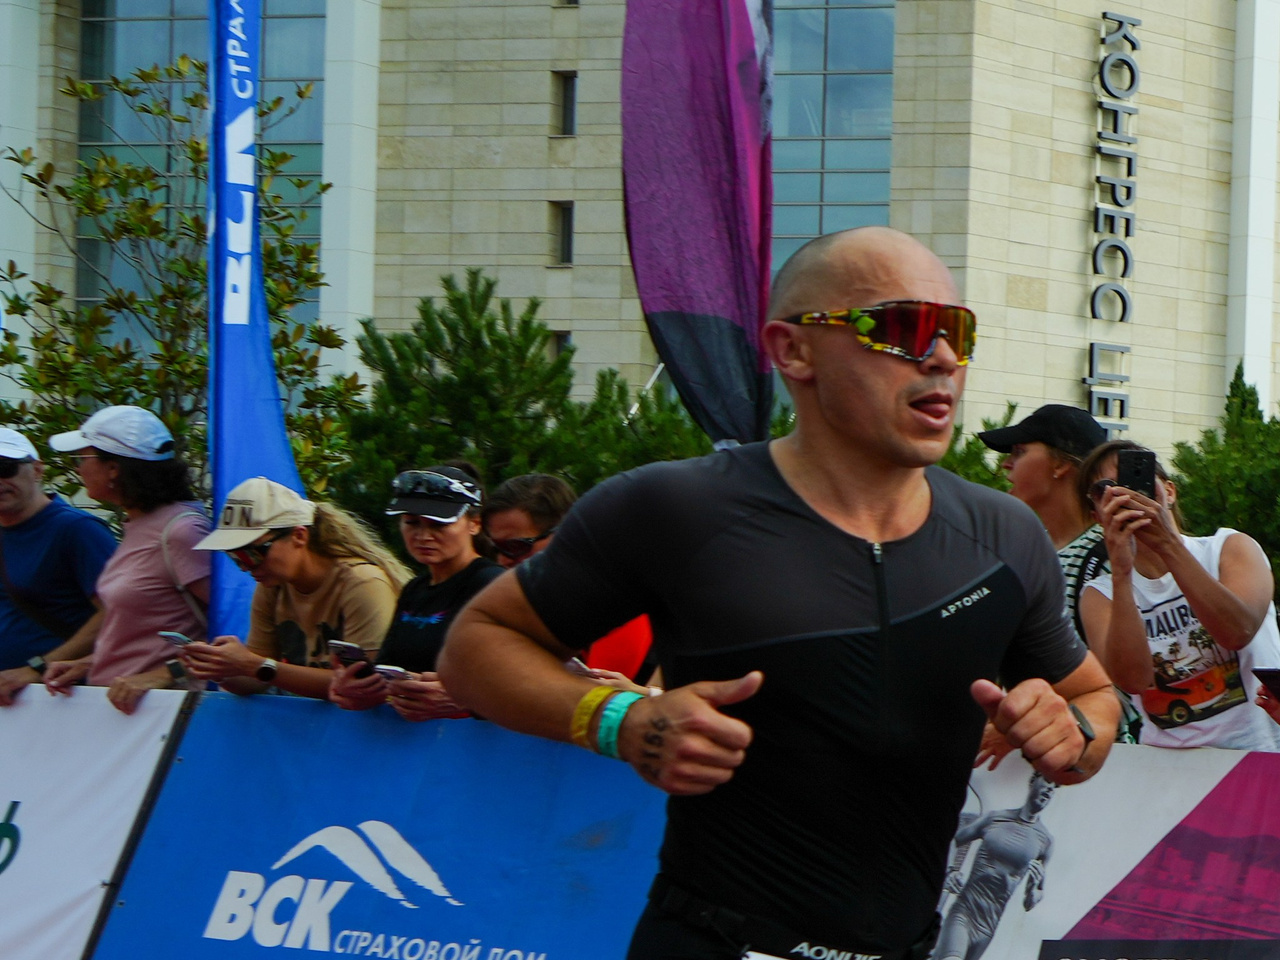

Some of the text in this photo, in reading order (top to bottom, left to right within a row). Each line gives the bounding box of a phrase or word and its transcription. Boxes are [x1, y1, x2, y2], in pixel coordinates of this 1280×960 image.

[1091, 11, 1142, 323] КОНГРЕСС
[940, 586, 992, 619] APTONIA
[1145, 604, 1198, 639] ALIB
[202, 870, 355, 952] ВСК
